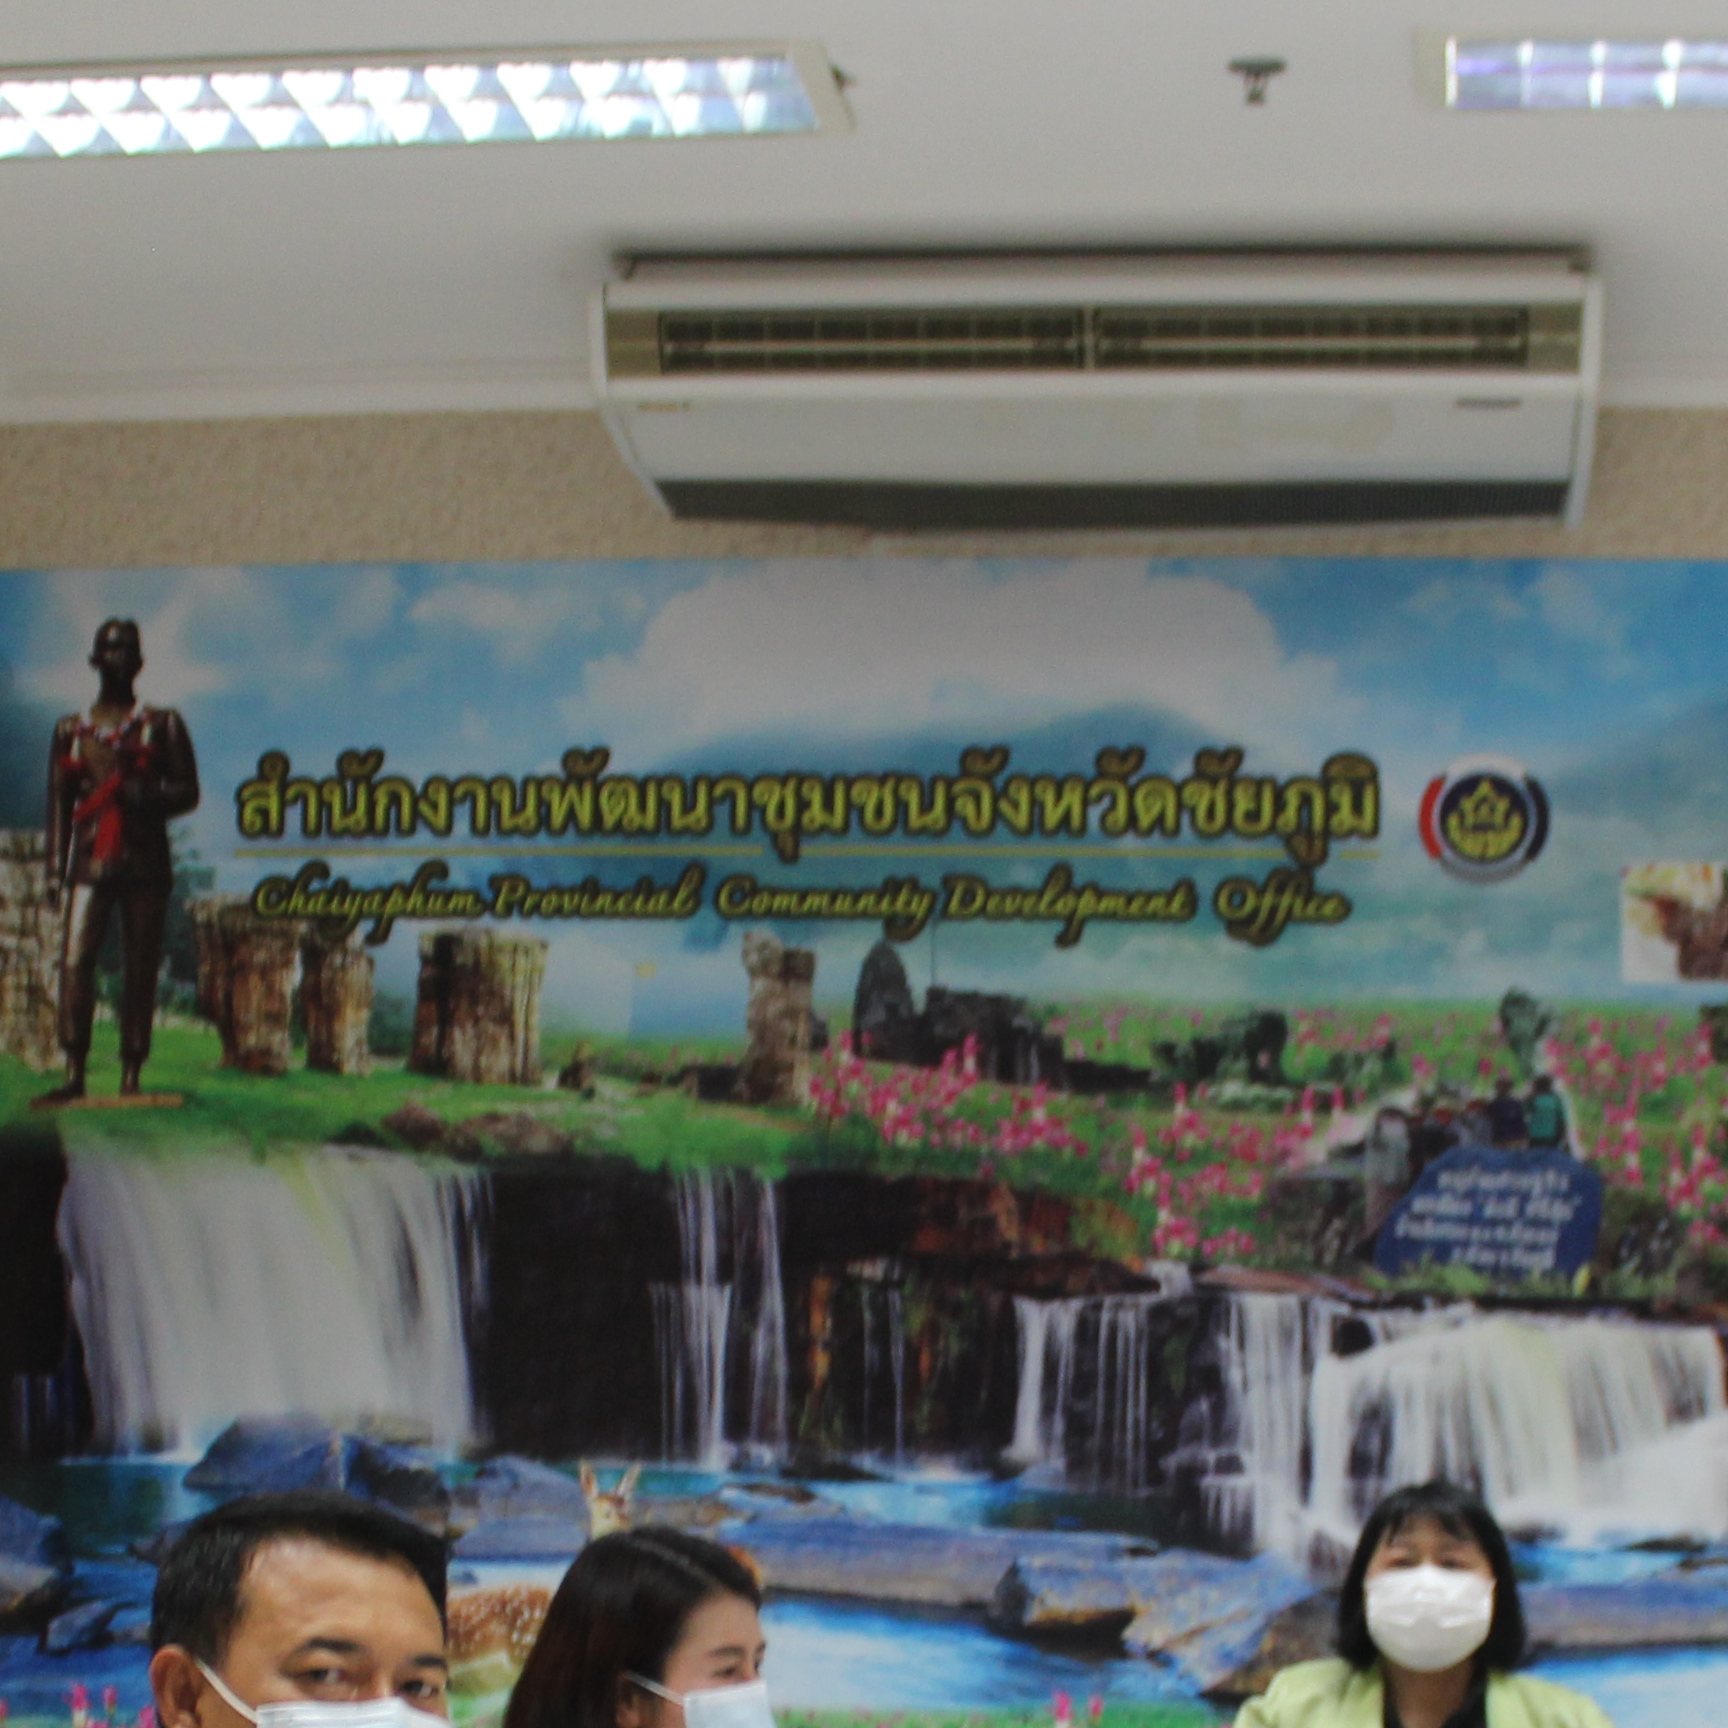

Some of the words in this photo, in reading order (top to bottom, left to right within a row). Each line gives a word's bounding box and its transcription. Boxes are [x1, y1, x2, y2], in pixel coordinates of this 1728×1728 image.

[235, 745, 1378, 865] สำนักงานพัฒนาชุมชนจังหวัดชัยภูมิ
[251, 860, 486, 945] Chaiyaphum
[488, 862, 706, 919] Provincial
[715, 873, 936, 942] Community
[941, 861, 1198, 947] Development
[1212, 867, 1353, 946] Office
